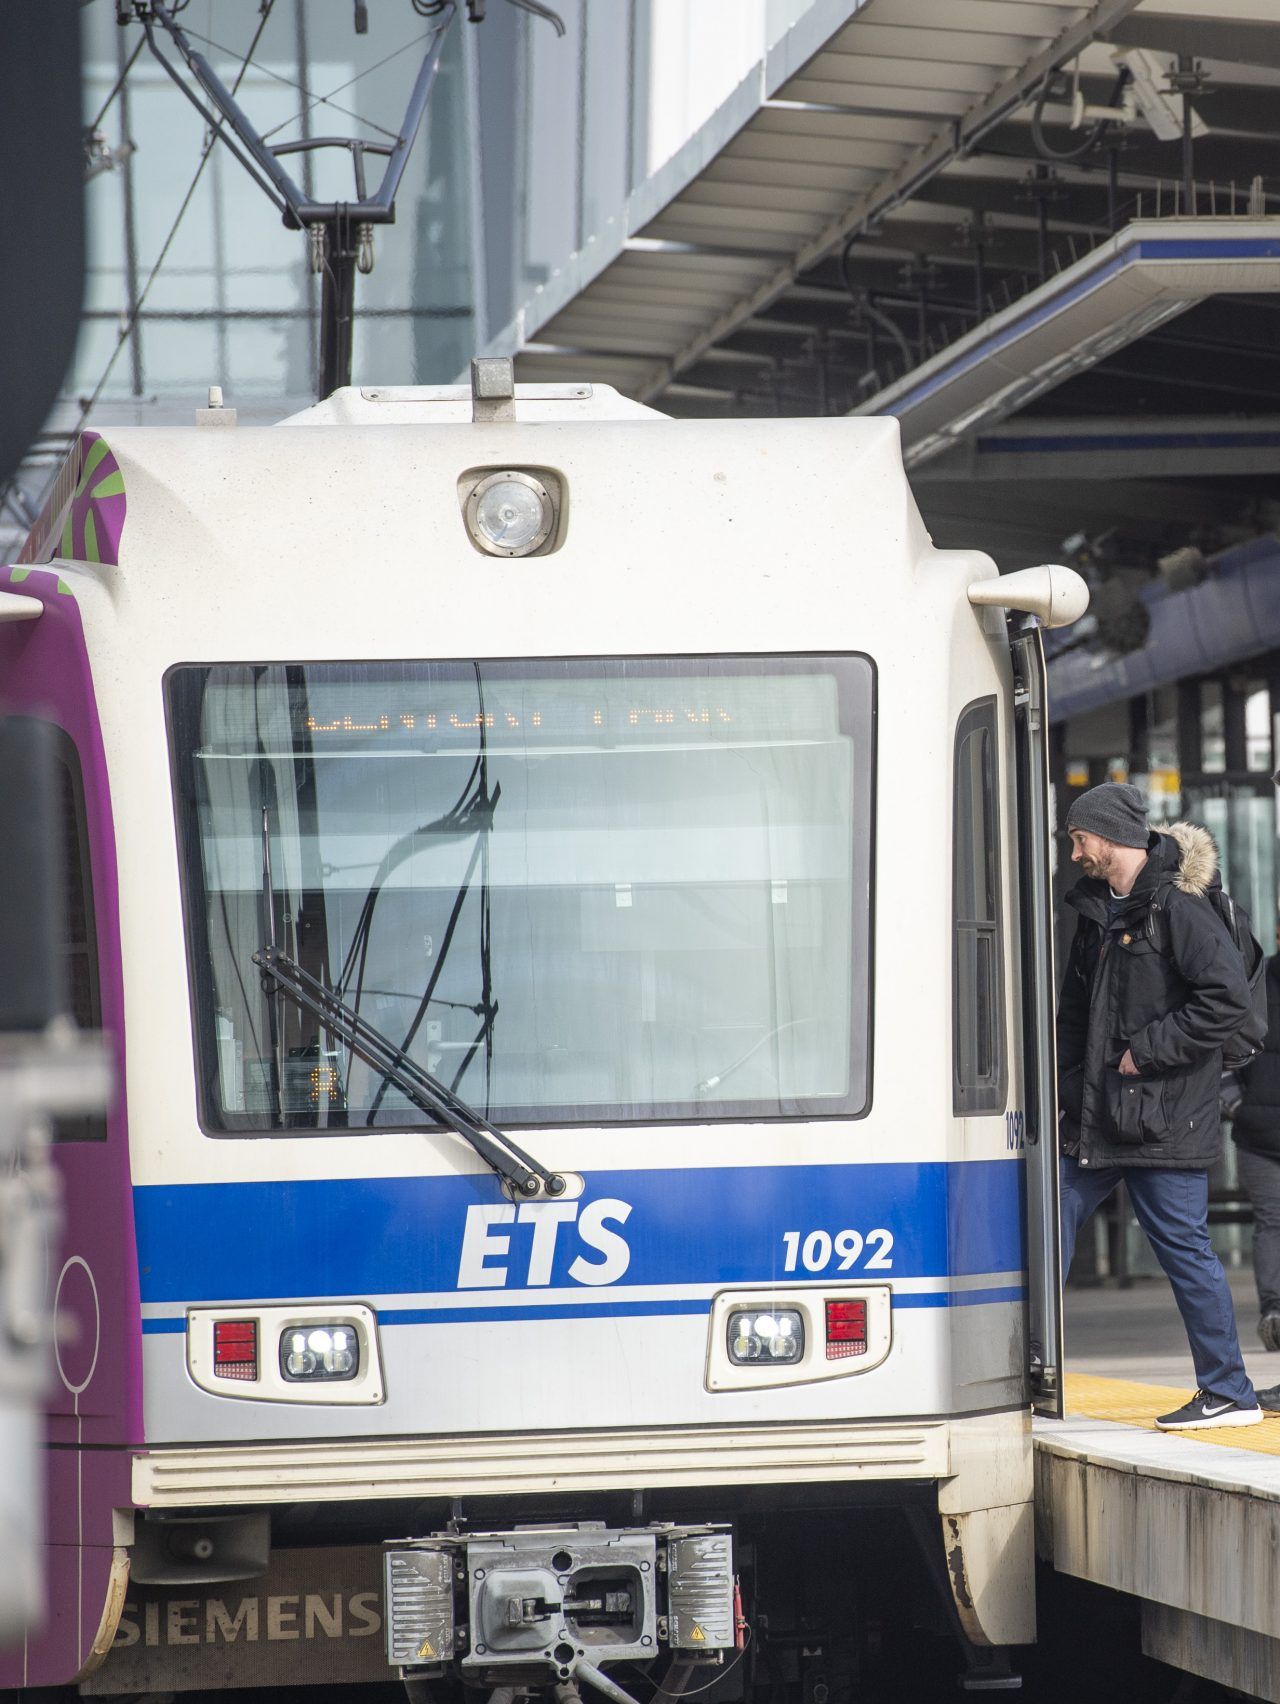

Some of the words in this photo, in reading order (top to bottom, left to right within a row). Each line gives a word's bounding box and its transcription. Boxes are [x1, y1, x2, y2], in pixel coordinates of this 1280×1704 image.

[1006, 1110, 1025, 1150] 1092
[457, 1198, 633, 1290] ETS
[782, 1229, 894, 1272] 1092
[110, 1592, 382, 1648] SIEMENS
